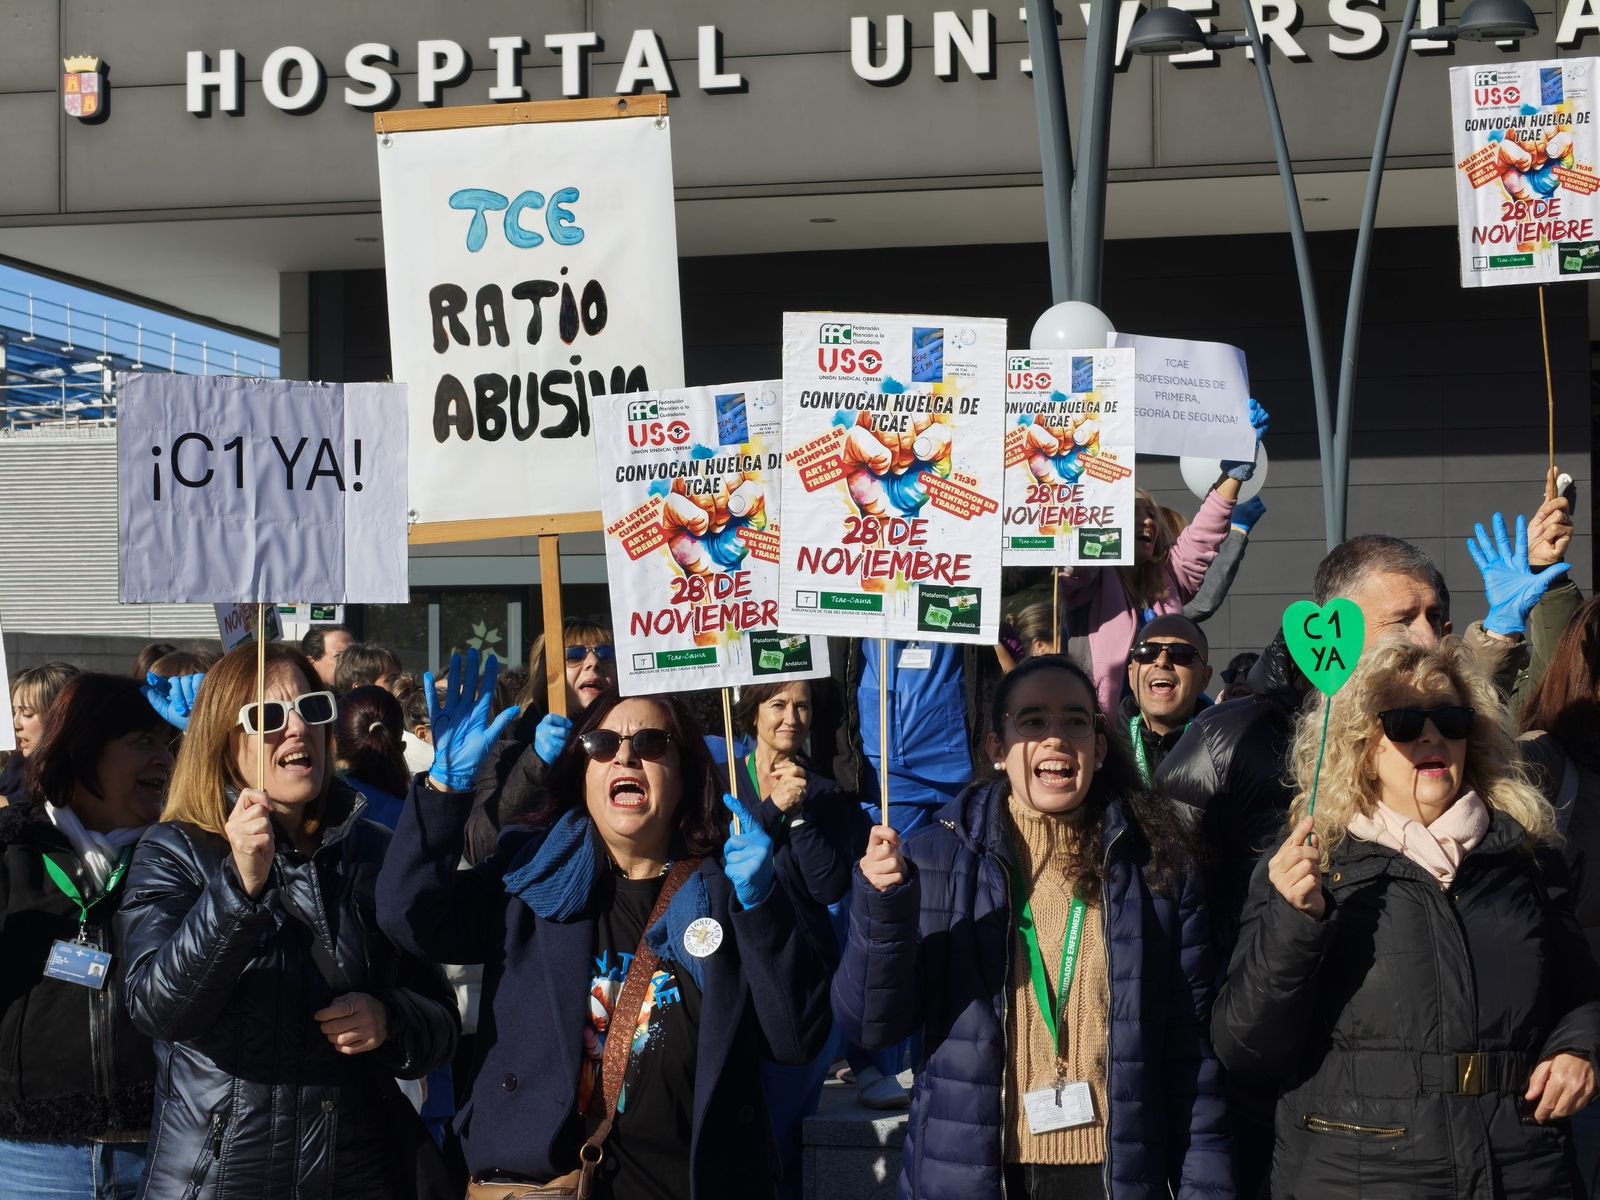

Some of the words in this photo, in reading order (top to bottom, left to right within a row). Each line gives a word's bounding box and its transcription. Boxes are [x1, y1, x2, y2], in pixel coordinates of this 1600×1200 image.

[186, 25, 741, 112] HOSPITAL
[1474, 86, 1521, 106] USO
[1465, 116, 1526, 131] CONVOCAN
[1530, 113, 1572, 127] HUELGA
[1576, 112, 1590, 124] DE
[1515, 129, 1541, 142] TCAE
[448, 186, 585, 253] TCE
[1501, 200, 1528, 222] 28
[1533, 198, 1561, 219] DE
[1472, 218, 1593, 245] NOVIEMBRE
[818, 347, 883, 375] USO
[1165, 358, 1190, 369] TCAE
[1008, 372, 1052, 390] USO
[1212, 380, 1227, 389] DE
[800, 390, 888, 412] CONVOCAN
[893, 393, 953, 414] HUELGA
[959, 397, 980, 415] DE
[1059, 401, 1100, 414] HUELGA
[1104, 401, 1118, 413] DE
[1155, 391, 1200, 404] PRIMERA,
[870, 414, 909, 433] TCAE
[1044, 415, 1070, 428] TCAE
[1172, 410, 1186, 420] DE
[1189, 411, 1239, 425] SEGUNDA!
[628, 420, 690, 447] USO
[805, 435, 828, 454] LEYES
[829, 428, 844, 441] SE
[796, 440, 841, 467] CUMPLEN!
[1101, 451, 1117, 460] 11:30
[152, 432, 244, 501] ¡C1
[271, 436, 363, 492] YA!
[616, 460, 699, 483] CONVOCAN
[705, 454, 763, 476] HUELGA
[804, 464, 825, 479] ART.
[825, 458, 838, 471] 76
[806, 468, 843, 488] TREBEP
[685, 477, 721, 497] TCAE
[952, 472, 977, 486] 11:30
[921, 474, 984, 508] CONCENTRACION
[984, 501, 996, 511] EN
[929, 487, 939, 496] EL
[939, 489, 968, 510] CENTRO
[968, 503, 980, 513] DE
[1025, 484, 1051, 504] 28
[1057, 484, 1085, 503] DE
[628, 503, 650, 522] LEYES
[649, 496, 661, 510] SE
[935, 497, 970, 518] TRABAJO
[618, 510, 660, 538] CUMPLEN!
[842, 516, 879, 545] 28
[887, 517, 929, 547] DE
[627, 533, 647, 548] ART.
[648, 527, 659, 539] 76
[631, 535, 664, 556] TREBEP
[797, 546, 972, 585] NOVIEMBRE
[670, 575, 705, 604] 28
[714, 570, 752, 600] DE
[630, 600, 779, 637] NOVIEMBR
[1303, 610, 1342, 640] C1
[752, 637, 779, 645] Plataforma
[1311, 646, 1346, 671] YA
[1067, 906, 1082, 955] ENFERMERÍA
[1062, 957, 1073, 998] CUIDADOS
